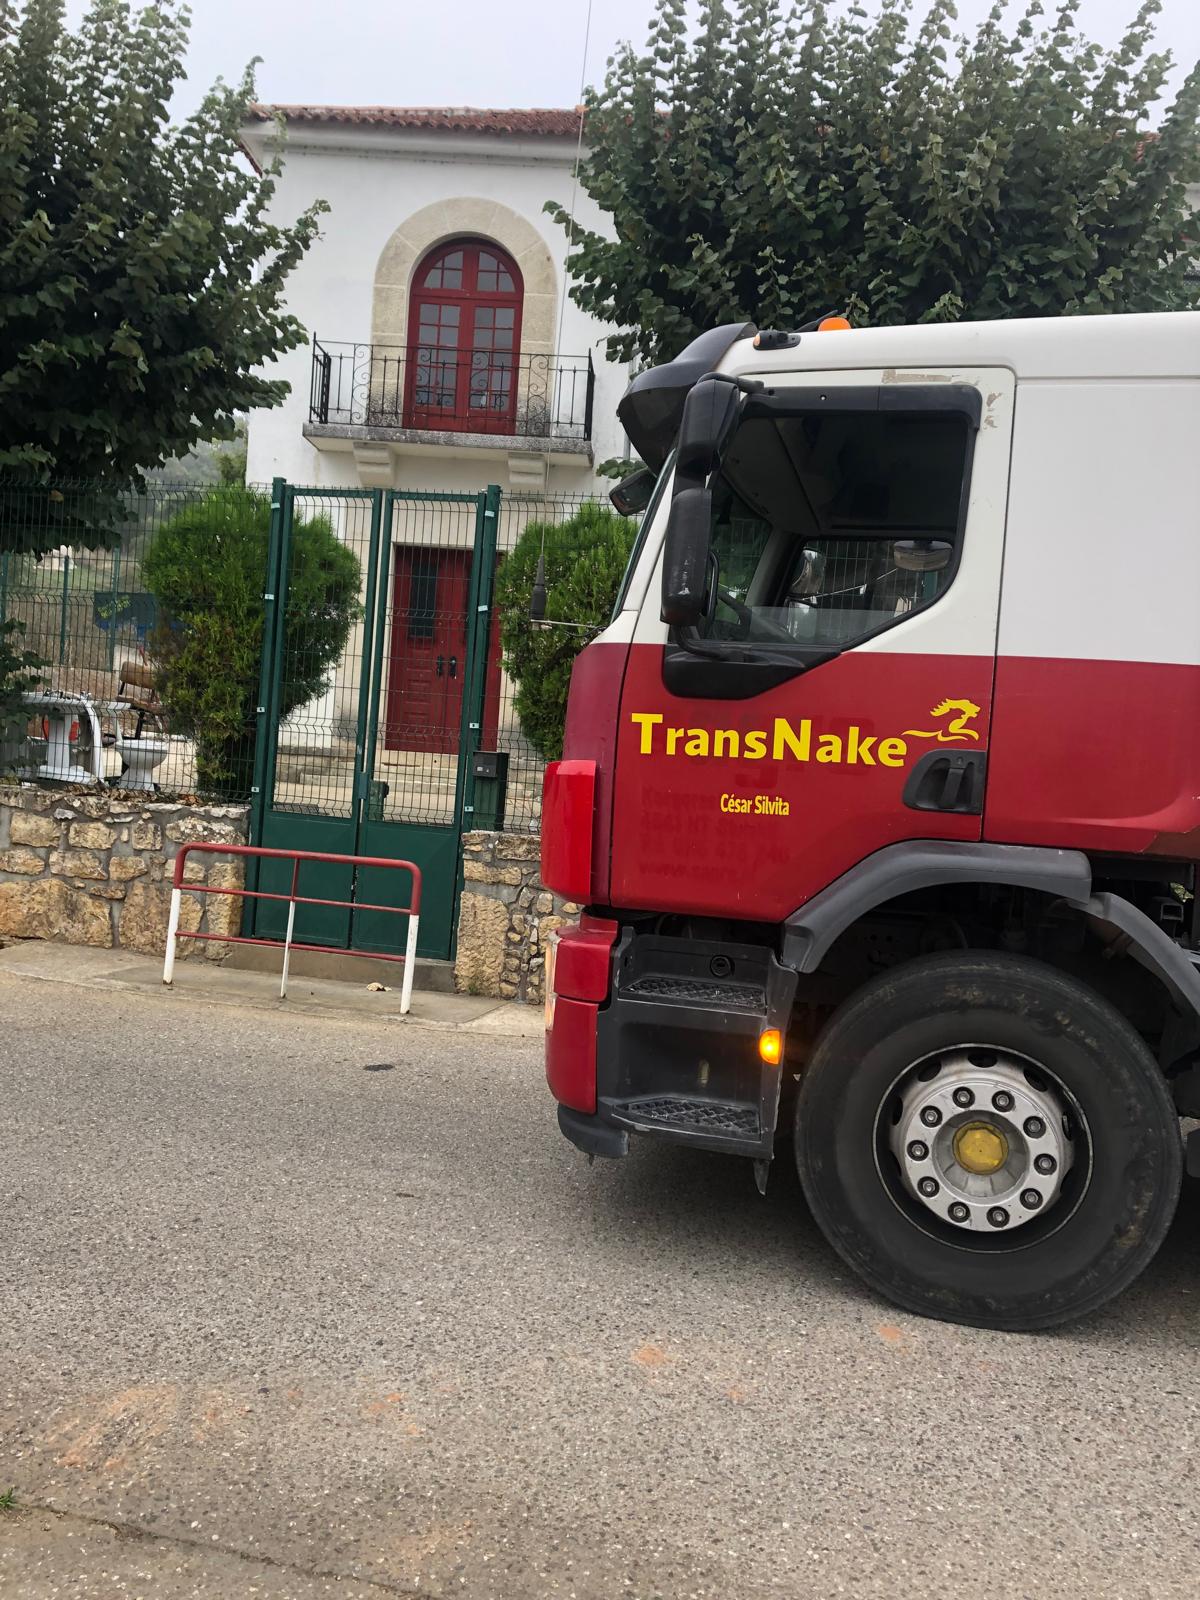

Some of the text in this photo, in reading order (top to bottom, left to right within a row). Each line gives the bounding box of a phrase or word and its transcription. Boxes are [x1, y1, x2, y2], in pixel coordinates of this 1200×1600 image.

[631, 712, 908, 767] TransNake
[720, 793, 753, 814] César
[754, 795, 790, 816] Silvita
